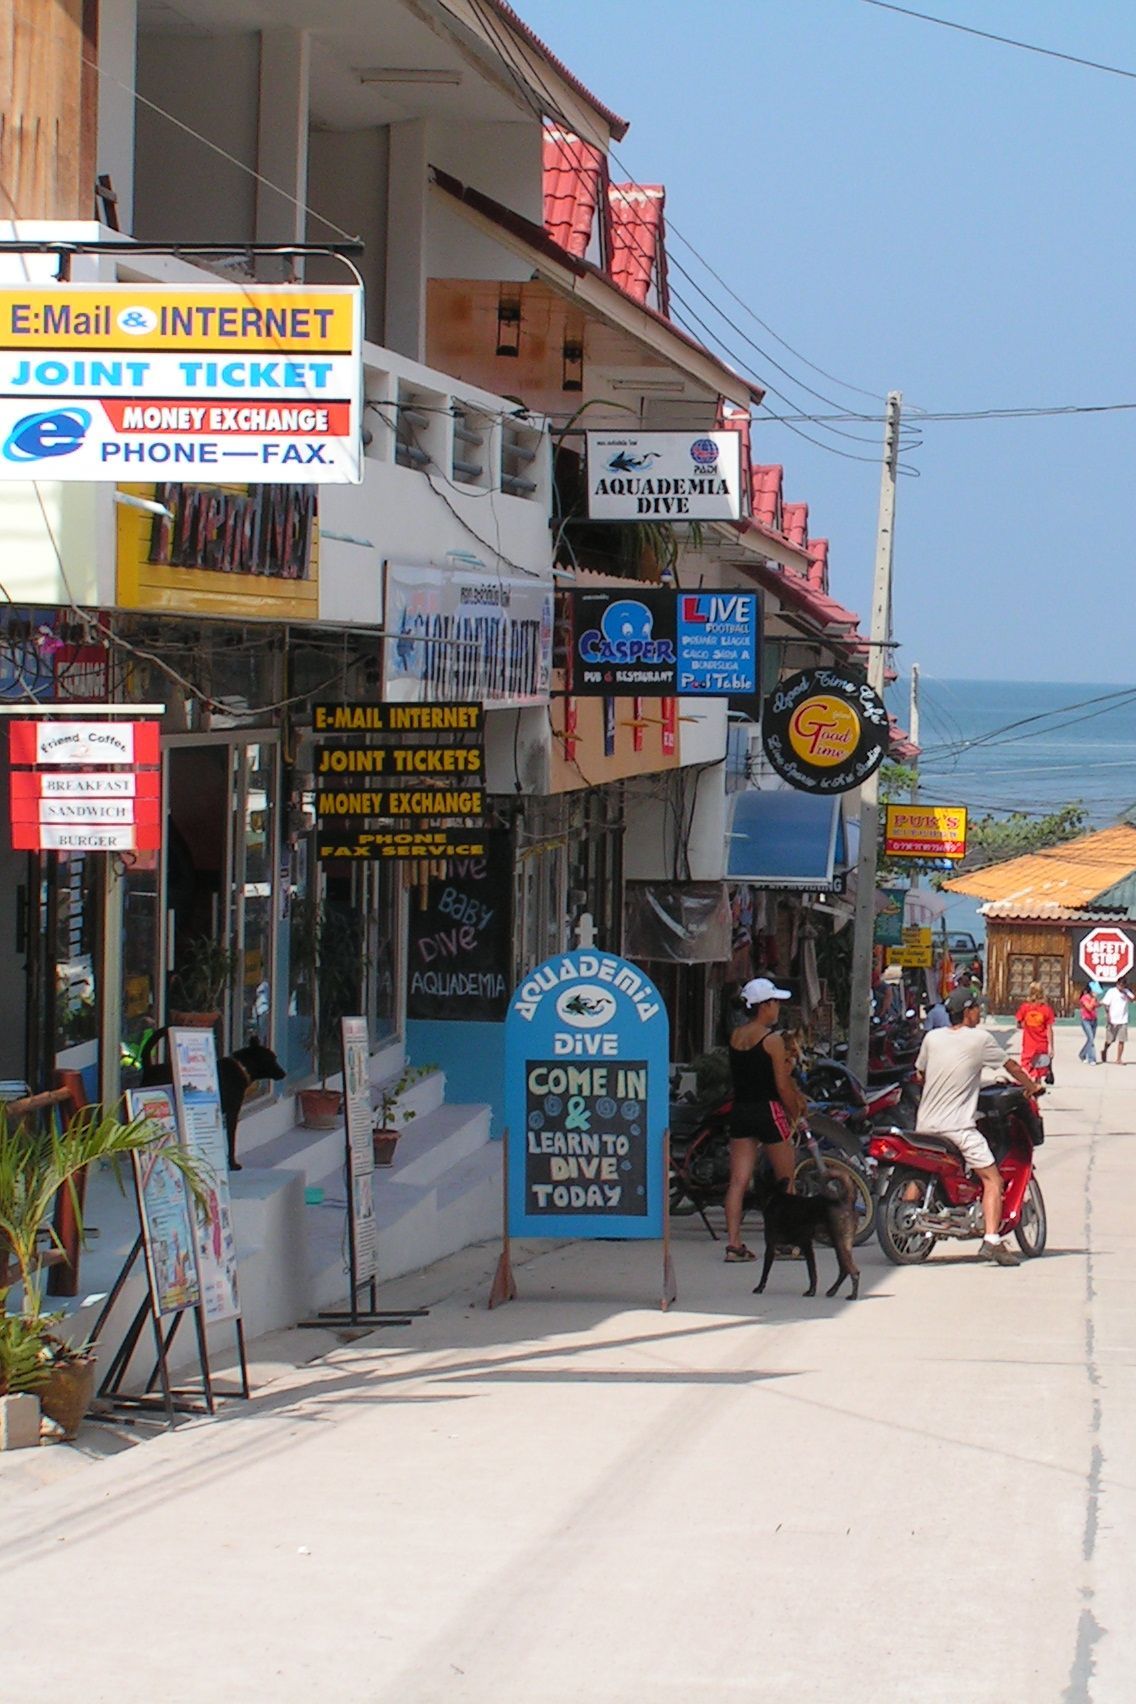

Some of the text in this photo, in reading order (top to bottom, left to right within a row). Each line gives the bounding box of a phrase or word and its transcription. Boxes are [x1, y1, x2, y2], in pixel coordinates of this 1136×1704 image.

[11, 305, 334, 338] E:Mail & INTERNET
[11, 361, 333, 388] JOINT TICKET
[123, 407, 329, 432] MONEY EXCHANGE
[594, 478, 730, 496] AQUADEMIA
[636, 497, 690, 514] DIVE
[683, 596, 750, 623] LIVE
[705, 624, 749, 633] FOOTBALL
[579, 629, 676, 664] CASPER
[584, 671, 602, 682] PUB
[616, 671, 674, 682] RESTAURANT
[682, 673, 752, 689] Pool Table
[316, 707, 479, 728] E-MAIL INTERNET
[40, 732, 127, 753] Friend Coffee
[319, 749, 481, 771] JOINT TICKETS
[47, 780, 129, 792] BREAKFAST
[49, 806, 125, 817] SANDWICH
[319, 792, 482, 814] MONEY EXCHANGE
[58, 835, 118, 847] BURGER
[358, 833, 447, 844] PHONE
[320, 844, 485, 857] FAX SERVICE
[1086, 940, 1126, 954] SAFETY
[1091, 953, 1120, 965] STOP
[411, 970, 507, 998] AQUADEMIA
[528, 1066, 647, 1100] COME IN
[564, 1096, 592, 1132] &
[527, 1132, 630, 1157] LEARN TO
[551, 1157, 619, 1182] DIVE
[532, 1183, 622, 1209] TODAY
